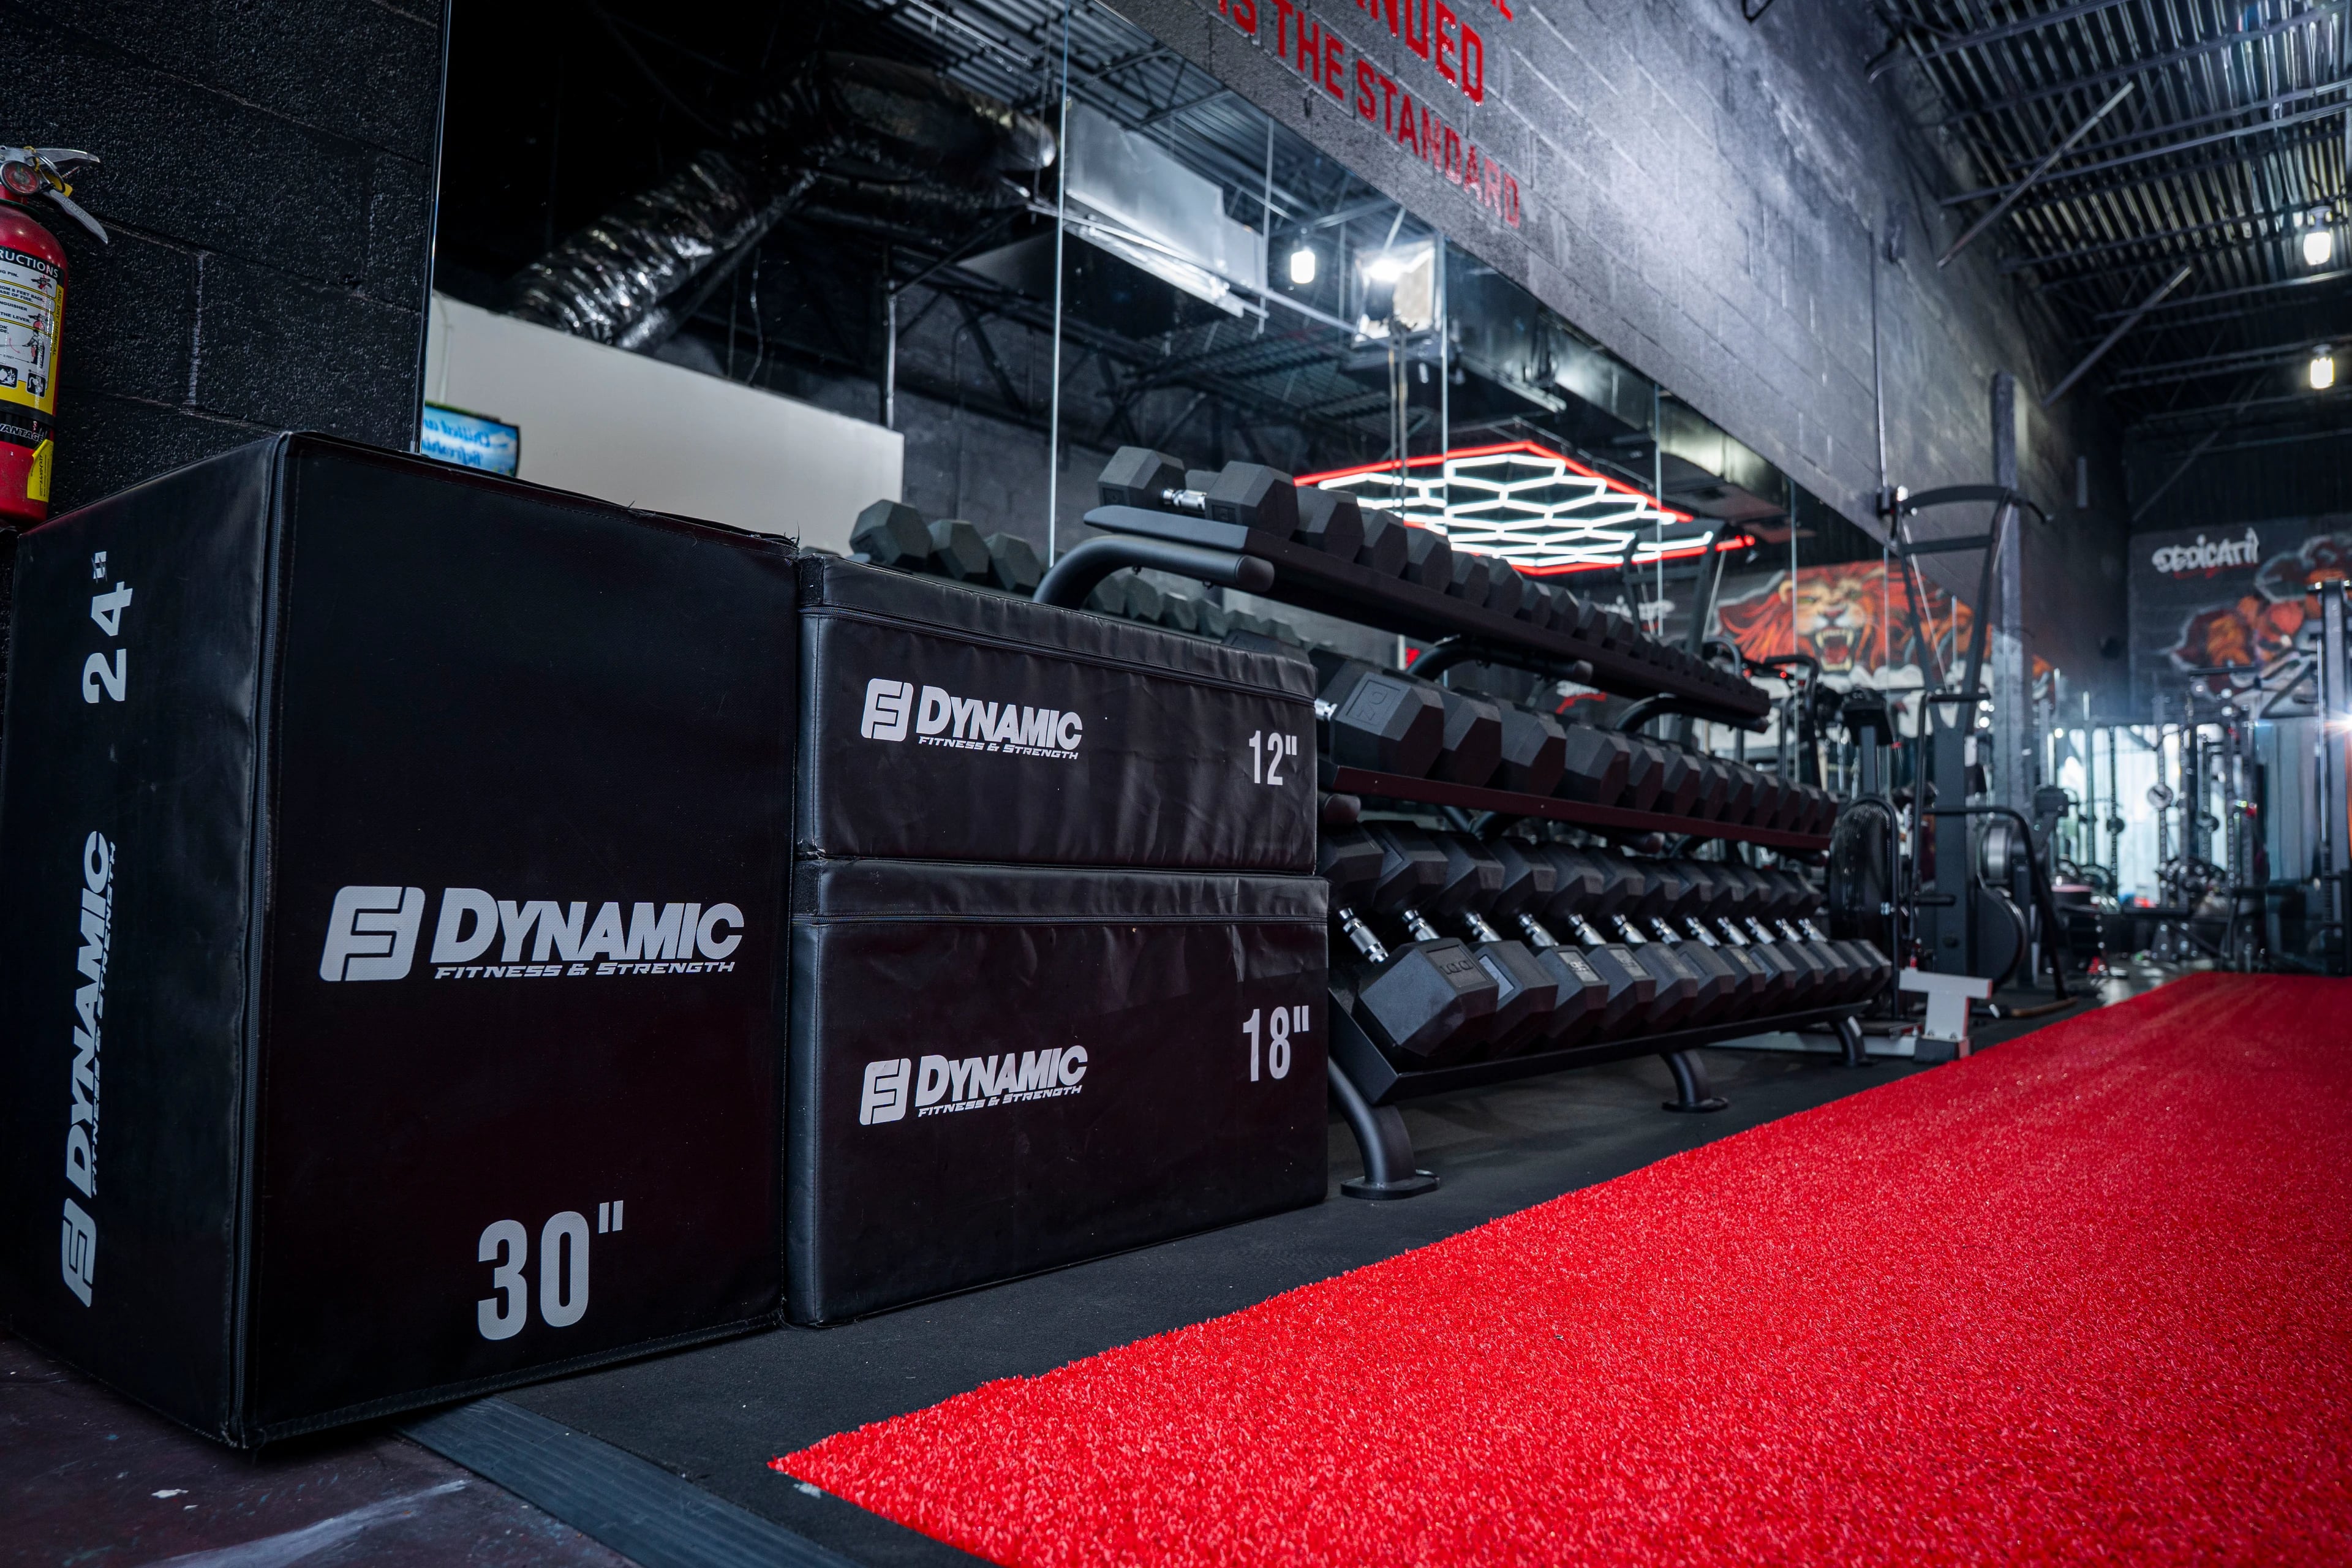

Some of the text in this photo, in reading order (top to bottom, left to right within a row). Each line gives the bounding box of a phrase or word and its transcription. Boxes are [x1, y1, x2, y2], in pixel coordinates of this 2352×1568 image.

[1272, 0, 1344, 102] THE
[1356, 58, 1520, 228] STANDARD
[13, 314, 31, 323] LEVER.
[82, 551, 134, 704] 24"
[916, 685, 1083, 751] DYNAMIC
[918, 736, 1079, 760] FITNESS & STRENGTH
[1249, 729, 1297, 785] 12"
[430, 888, 745, 963] DYNAMIC
[434, 962, 735, 979] FITNESS & STRENGTH
[66, 831, 110, 1199] DYNAMIC
[91, 841, 116, 1196] FITNESS & STRENGTH
[1242, 1005, 1310, 1082] 18"
[914, 1045, 1088, 1107] DYNAMIC
[918, 1085, 1083, 1117] FITNESS & STRENGTH
[478, 1200, 624, 1341] 30"
